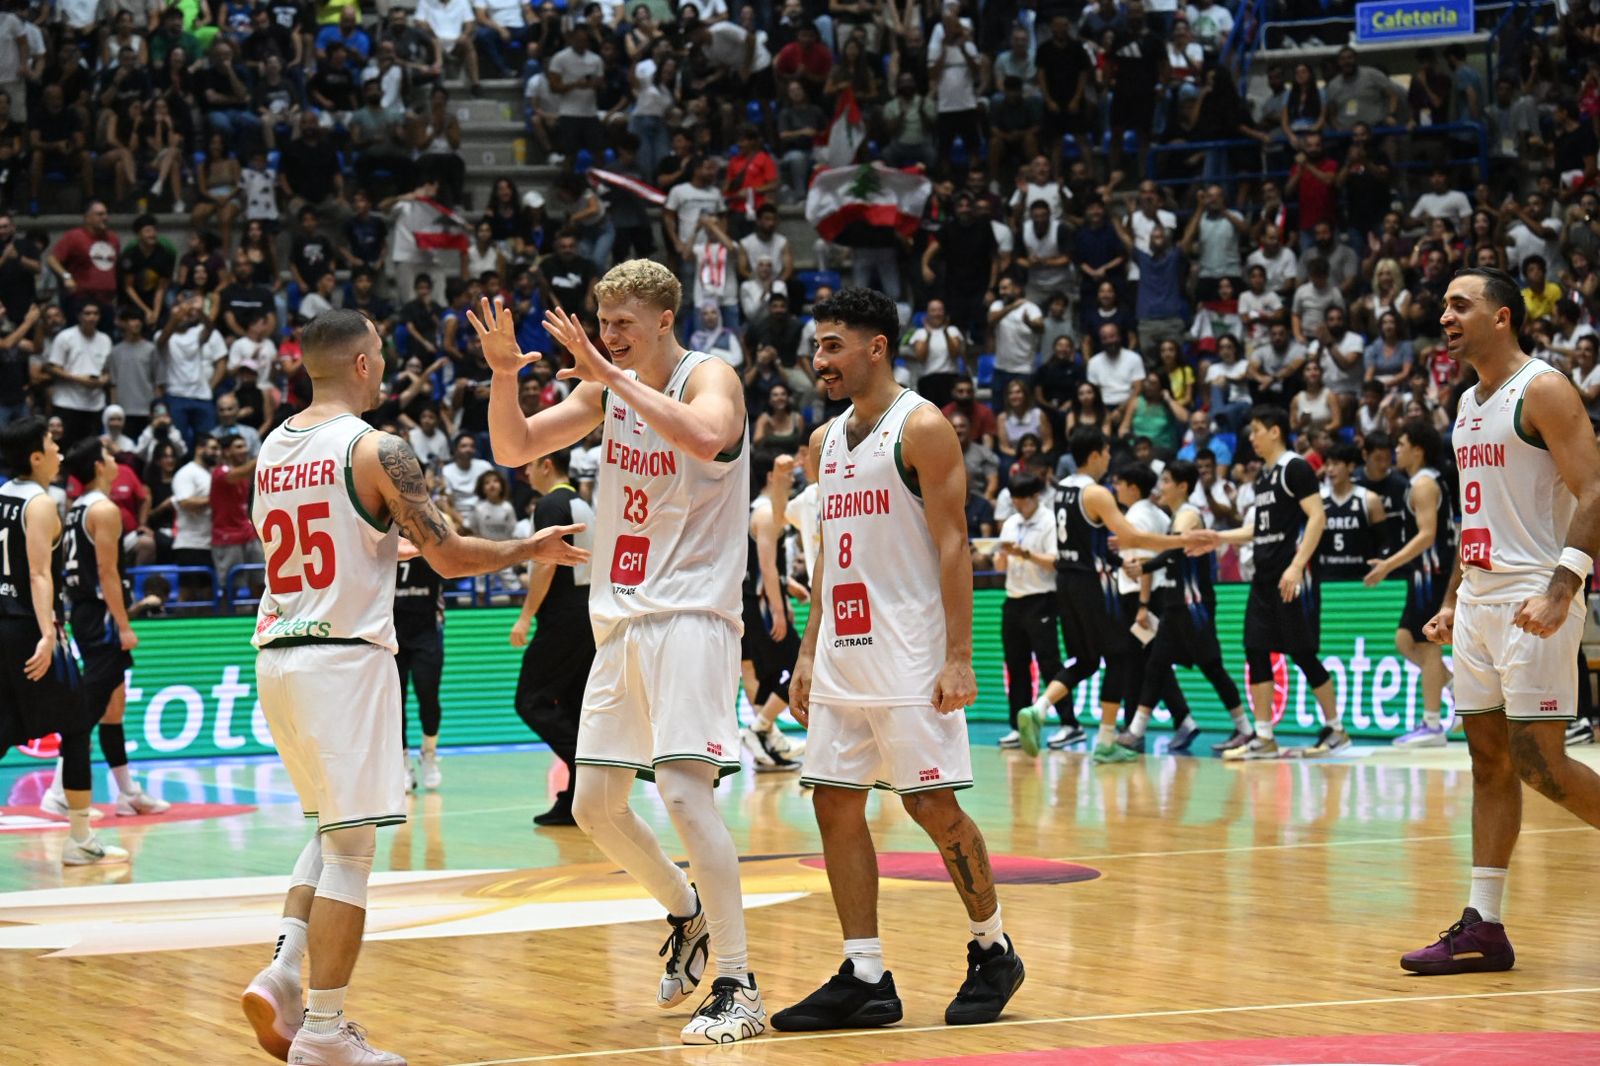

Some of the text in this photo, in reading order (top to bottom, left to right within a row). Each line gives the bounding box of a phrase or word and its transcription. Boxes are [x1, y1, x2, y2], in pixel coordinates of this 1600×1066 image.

[1372, 7, 1457, 29] Cafeteria
[258, 459, 335, 496] MEZHER
[623, 486, 649, 524] 23
[1465, 481, 1481, 515] 9
[1325, 516, 1360, 530] OREA
[262, 501, 336, 595] 25
[838, 532, 853, 569] 8
[1333, 533, 1345, 552] 5
[1463, 542, 1486, 562] CFI
[619, 551, 643, 572] CFI
[400, 562, 411, 583] 7
[836, 599, 865, 620] CFI
